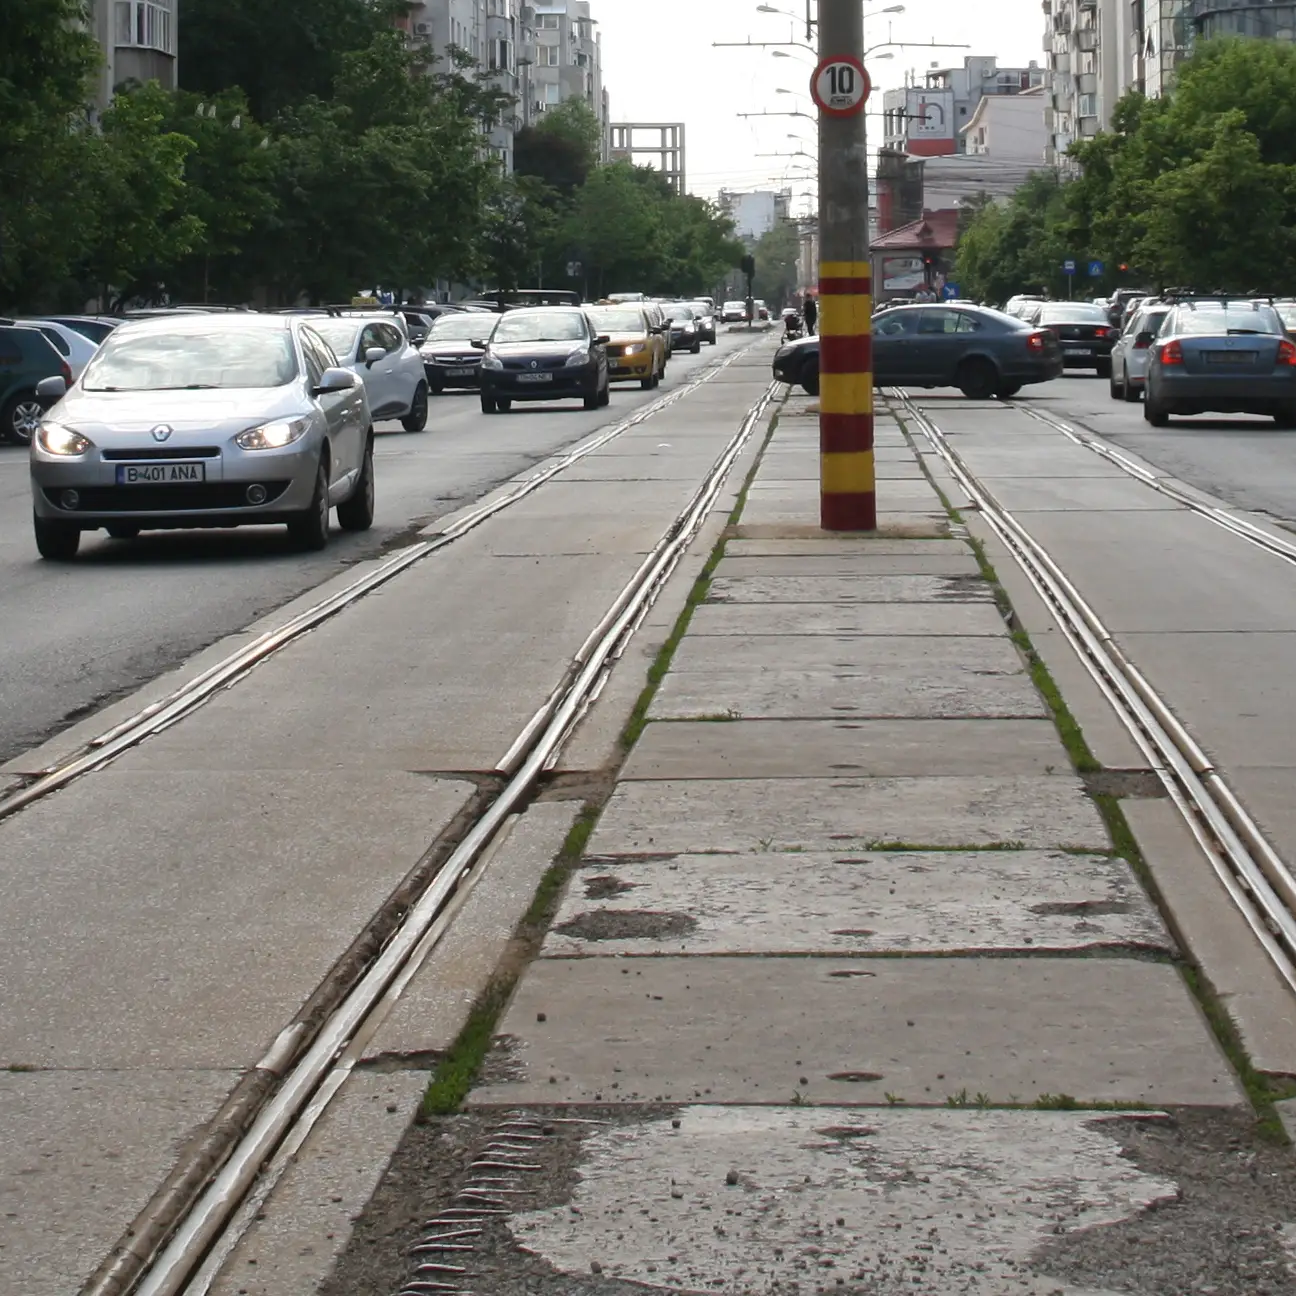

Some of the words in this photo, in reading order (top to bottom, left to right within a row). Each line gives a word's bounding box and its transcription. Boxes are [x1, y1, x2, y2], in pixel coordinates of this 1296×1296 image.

[826, 65, 854, 95] 10
[127, 467, 138, 482] B
[143, 466, 165, 481] 401
[170, 465, 198, 481] ANA
